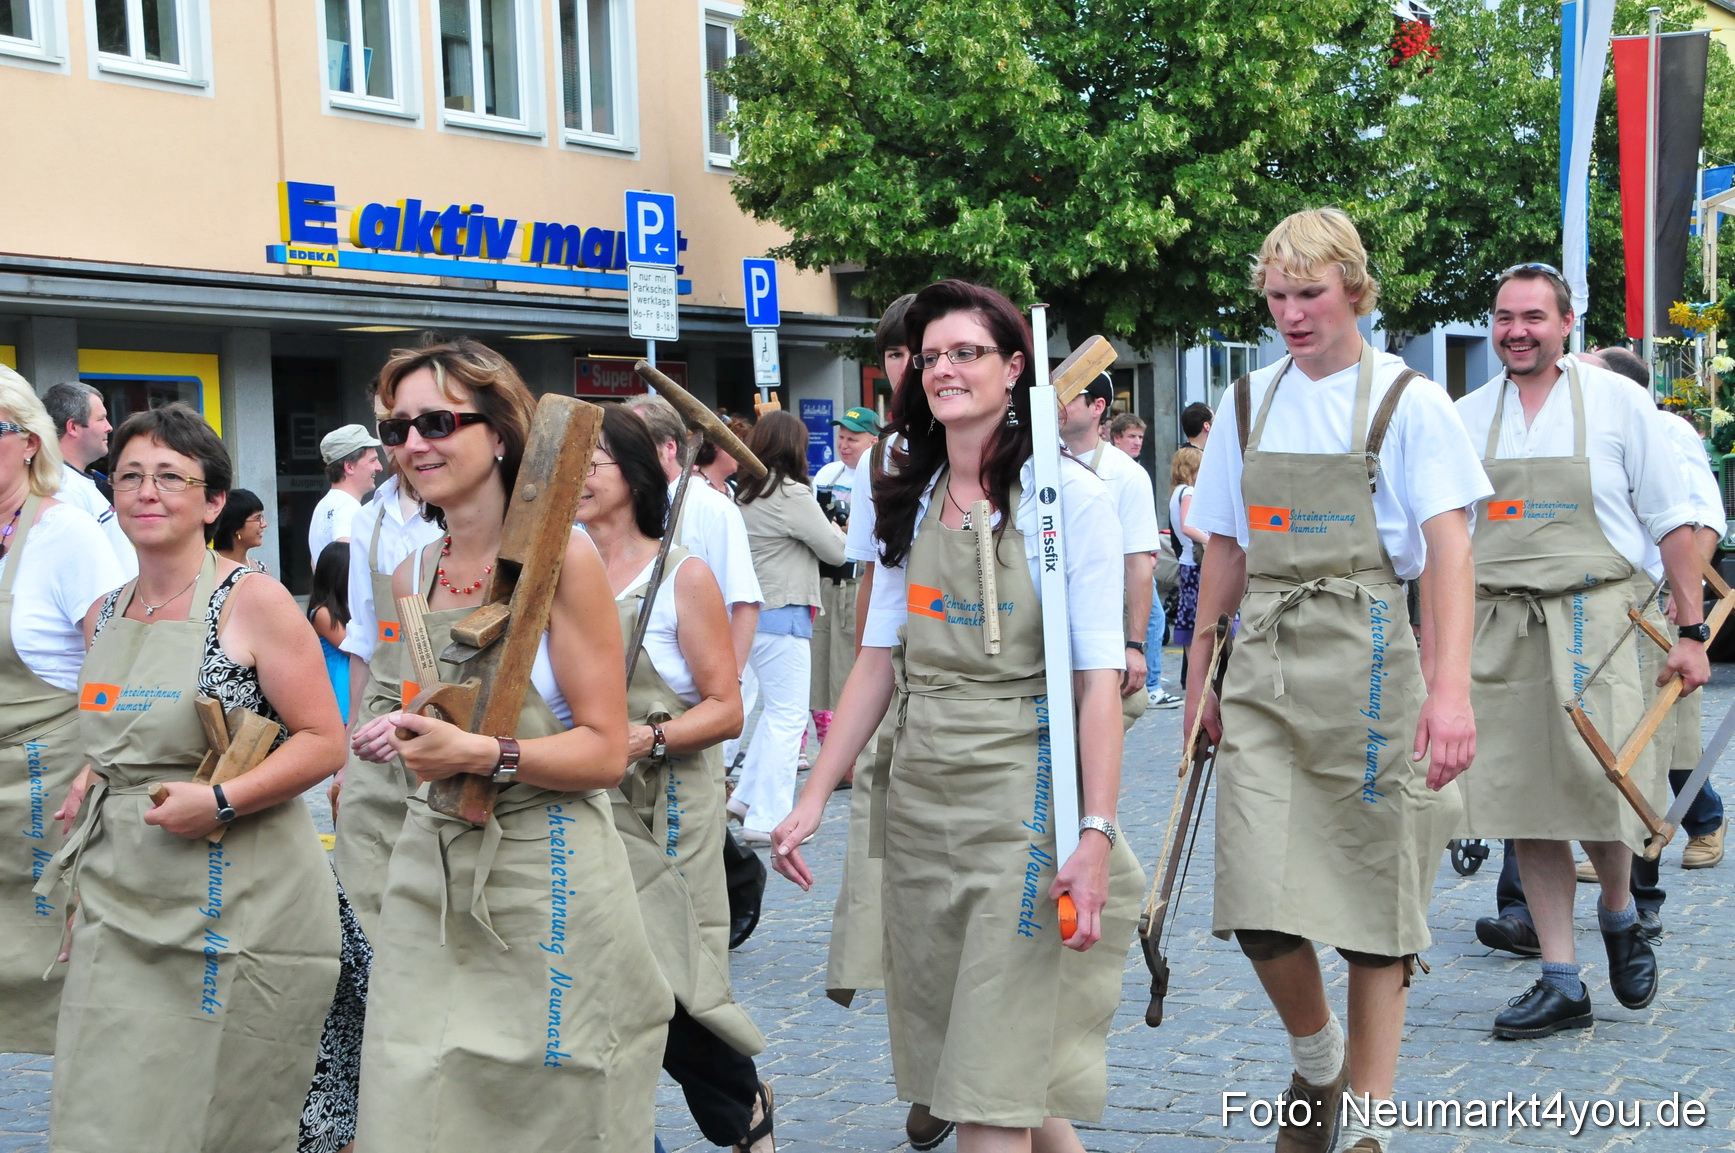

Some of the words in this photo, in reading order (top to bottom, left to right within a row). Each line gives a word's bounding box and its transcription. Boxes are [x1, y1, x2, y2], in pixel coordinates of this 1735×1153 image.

[279, 181, 338, 245] E
[350, 198, 518, 259] aktiv
[637, 201, 664, 254] P
[288, 249, 336, 264] EDEKA
[633, 282, 673, 295] Parkschein
[639, 273, 651, 282] nur
[655, 274, 666, 283] mit
[637, 296, 671, 308] werktags
[751, 267, 770, 317] P
[633, 309, 653, 318] Mo-Fr
[633, 321, 642, 330] Sa
[592, 363, 633, 393] Super
[290, 478, 324, 489] Ausgang
[1522, 510, 1556, 519] Neumarkt
[1523, 499, 1579, 513] Schreinerinnung
[1288, 509, 1356, 526] Schreinerinnung
[1288, 522, 1328, 534] Neumarkt
[1042, 515, 1058, 573] mEssfix
[943, 594, 1014, 616] Schreinerung
[1360, 596, 1391, 720] Schreinerinnung
[1362, 728, 1388, 804] Neumarkt
[539, 801, 576, 955] chreinerinnung
[1017, 844, 1052, 937] Neumarkt
[202, 928, 229, 1015] Neumarkt
[543, 967, 573, 1068] Neumarkt
